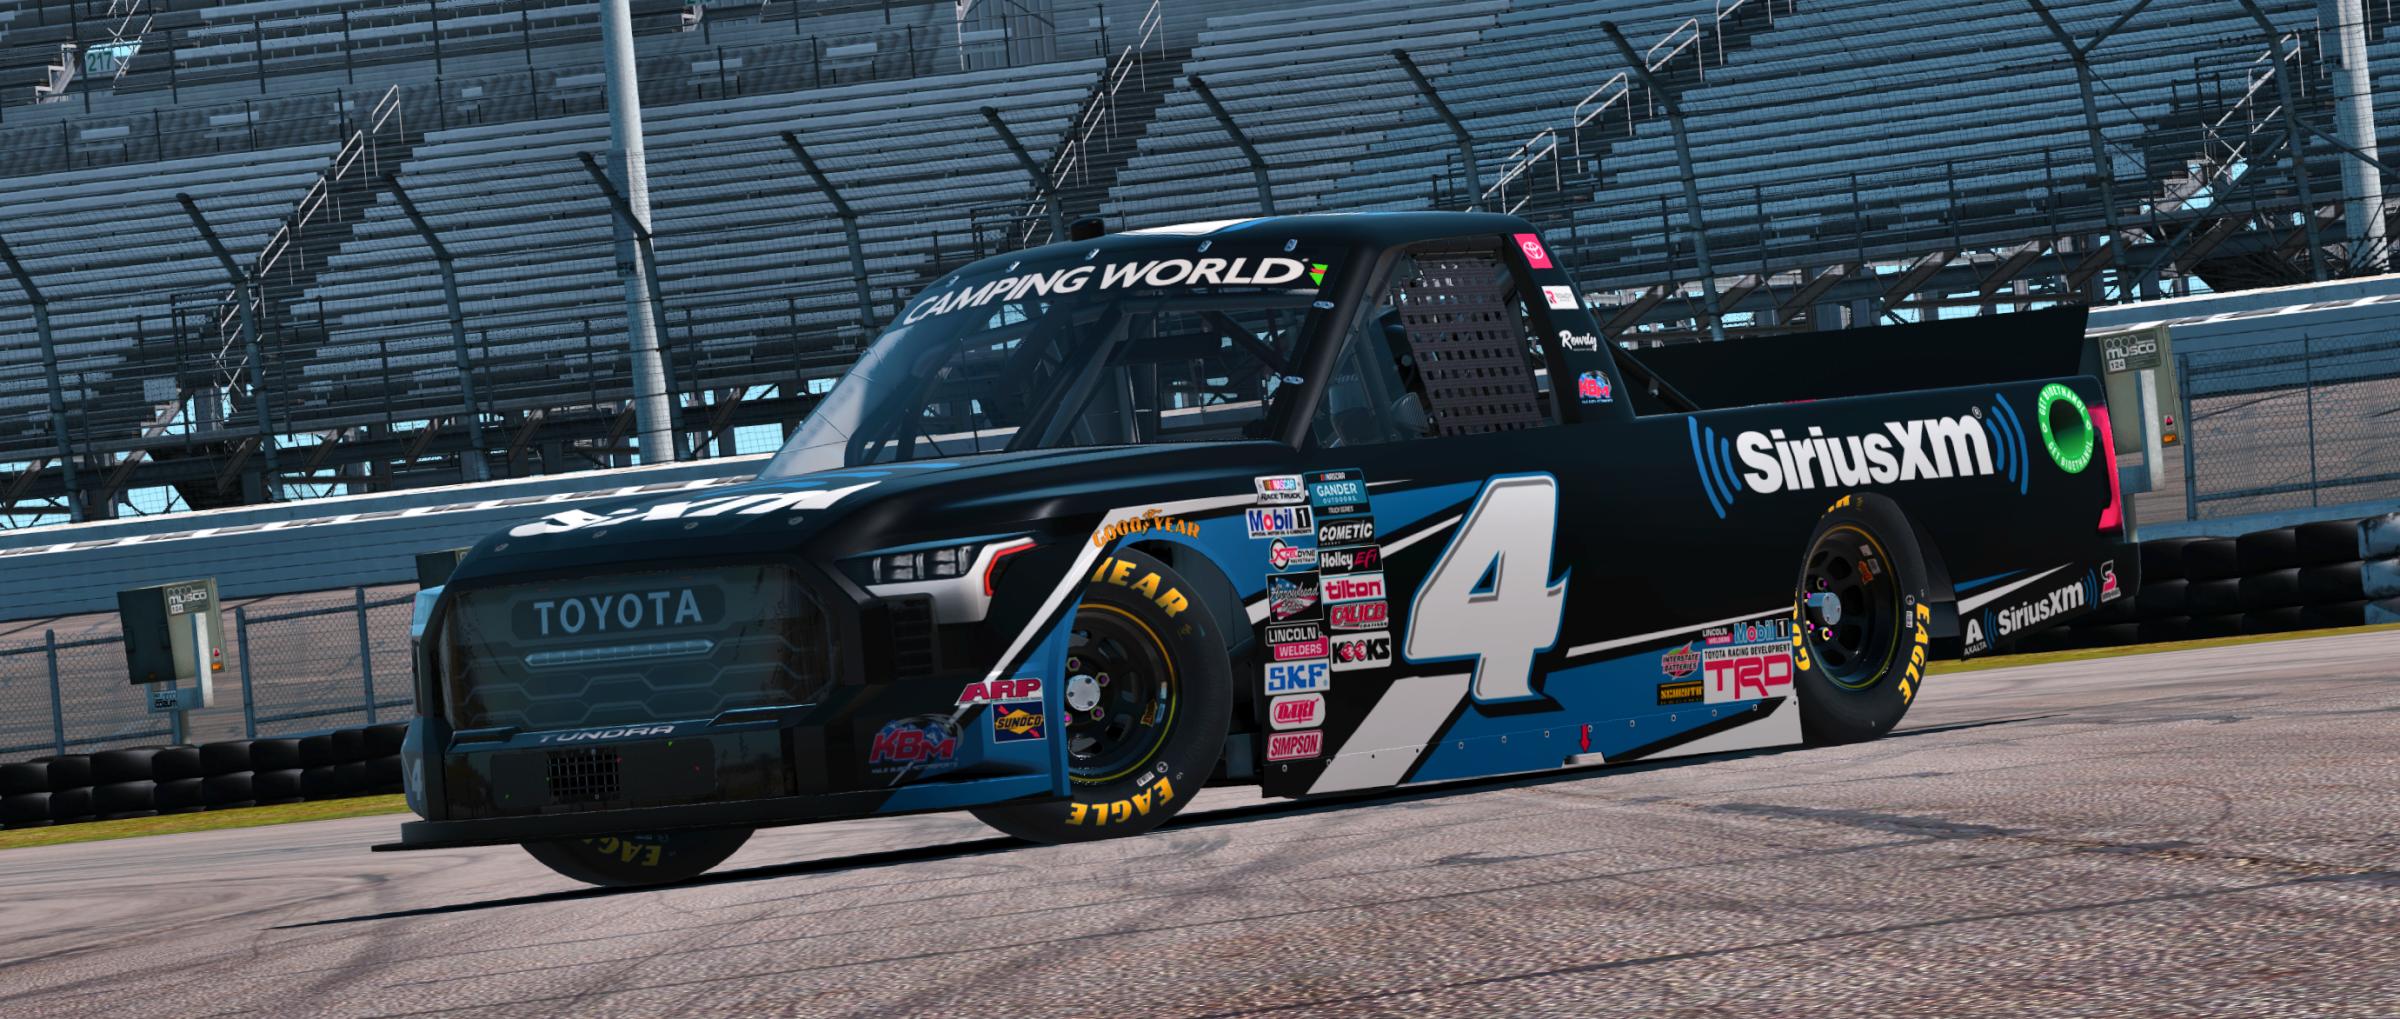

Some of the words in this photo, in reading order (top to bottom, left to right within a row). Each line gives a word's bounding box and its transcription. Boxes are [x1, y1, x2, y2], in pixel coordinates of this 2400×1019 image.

[88, 51, 112, 72] 217
[903, 265, 1096, 326] CAMPING
[1100, 257, 1306, 289] WORLD
[1559, 330, 1598, 352] Rowdy
[1265, 478, 1297, 491] NASCAR
[1321, 472, 1346, 480] NASCAR
[1316, 482, 1358, 497] GANDER
[1322, 496, 1357, 504] OUTDOORS
[1248, 508, 1293, 532] Mobil
[1319, 521, 1373, 541] COMETIC
[1321, 551, 1354, 570] Holley
[1270, 581, 1319, 601] Arrowhead
[1325, 579, 1382, 600] tilton
[1403, 471, 1572, 705] 4
[533, 589, 703, 635] TOYOTA
[1331, 602, 1388, 625] CALICO
[1268, 626, 1317, 643] LINCOLN
[1702, 627, 1728, 638] LINCOLN
[1734, 619, 1775, 645] Mobil
[1279, 643, 1323, 658] WELDERS
[1332, 637, 1390, 665] KOOKS
[1662, 654, 1699, 663] INTERSTATE
[1704, 650, 1726, 660] TOYOTA
[1727, 647, 1750, 658] RACING
[1750, 643, 1791, 656] DEVELOPMENT
[1898, 602, 1931, 705] EAGLE
[1963, 640, 1988, 656] AXALTA
[1268, 663, 1328, 692] SKF
[1664, 663, 1697, 672] BATTERIES
[1704, 654, 1793, 700] TRD
[957, 678, 1042, 702] ARP
[996, 716, 1043, 729] SUNOCO
[539, 725, 676, 744] TUNDRA
[868, 728, 957, 764] KBM
[1271, 733, 1319, 758] SIMPSON
[1065, 776, 1175, 826] EAGLE
